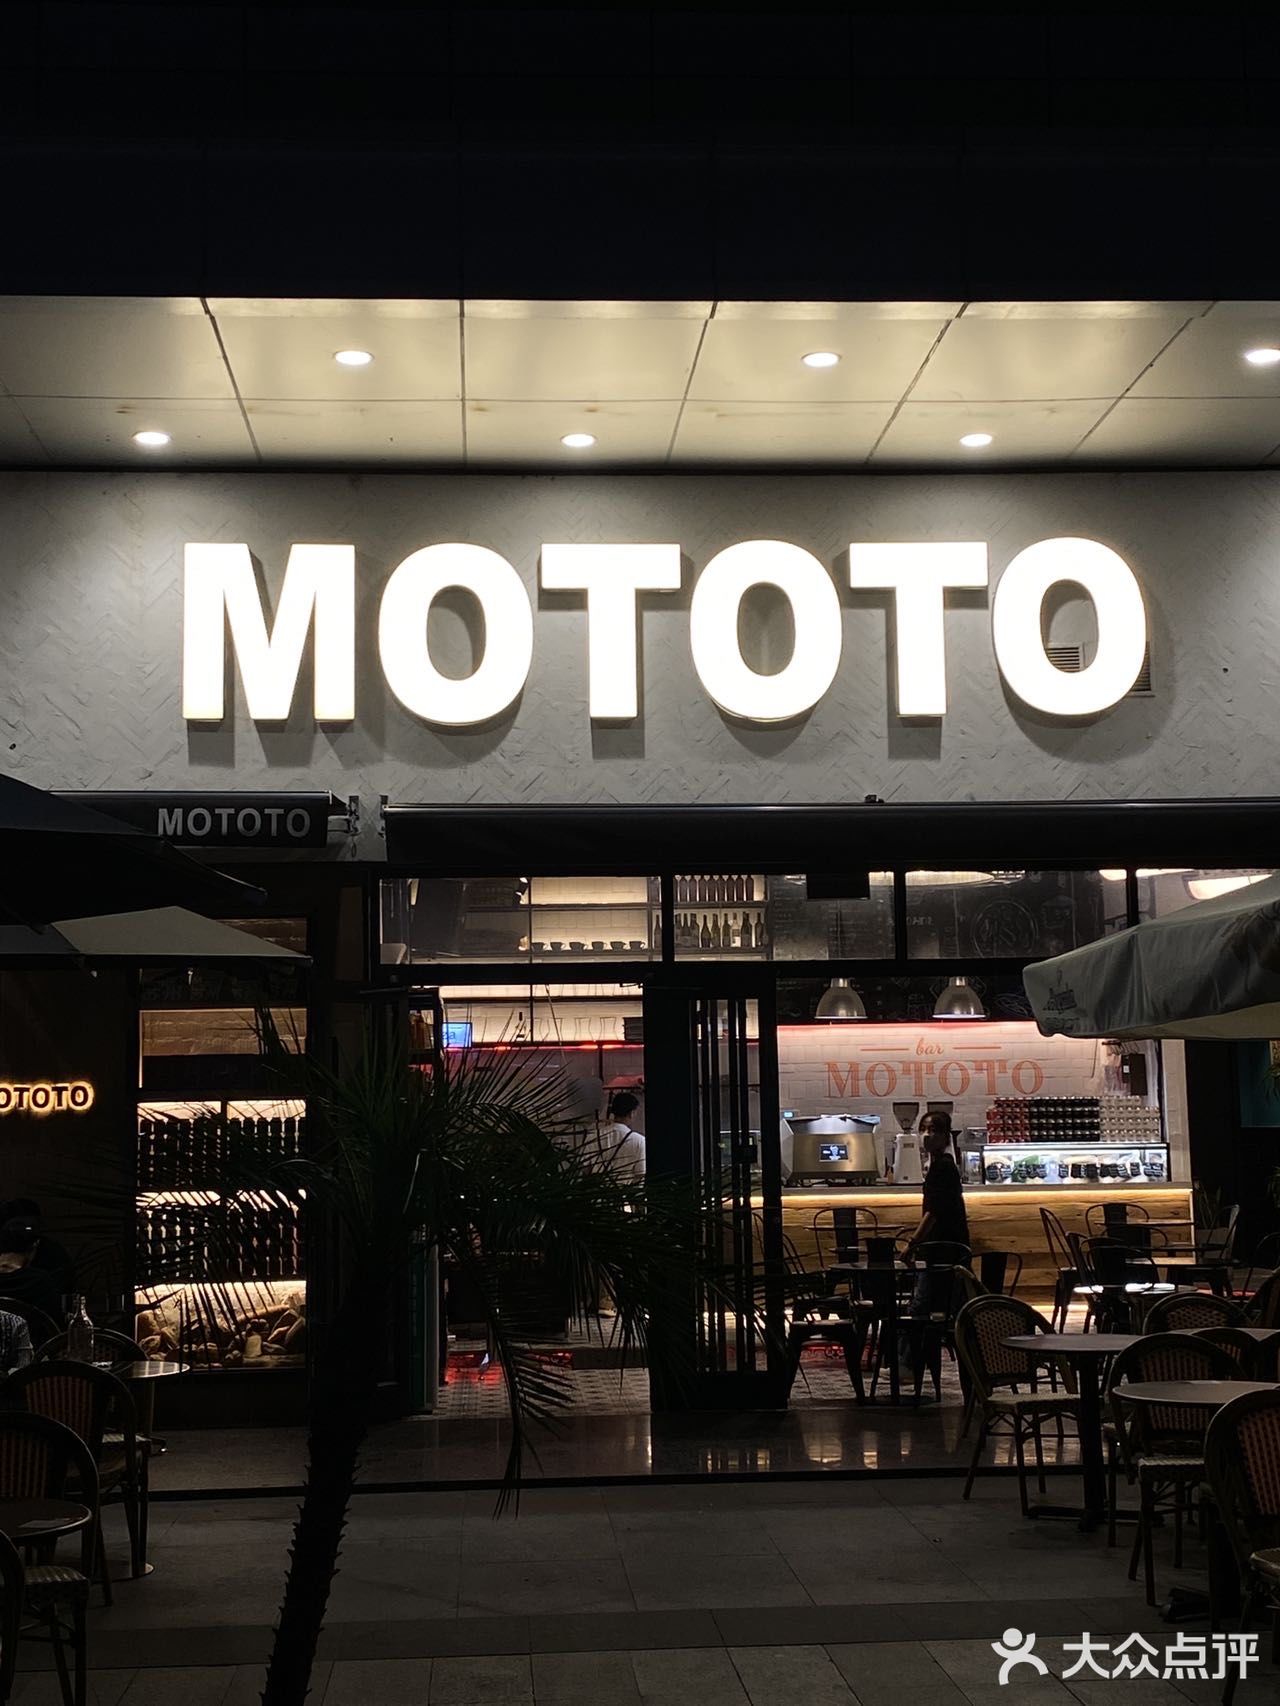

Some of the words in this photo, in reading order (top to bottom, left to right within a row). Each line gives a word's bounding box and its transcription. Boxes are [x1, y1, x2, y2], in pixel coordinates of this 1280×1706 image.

[182, 537, 1147, 725] MOTOTO
[158, 807, 311, 838] MOTOTO
[915, 1038, 945, 1056] bar
[825, 1059, 1044, 1098] MOTOTO
